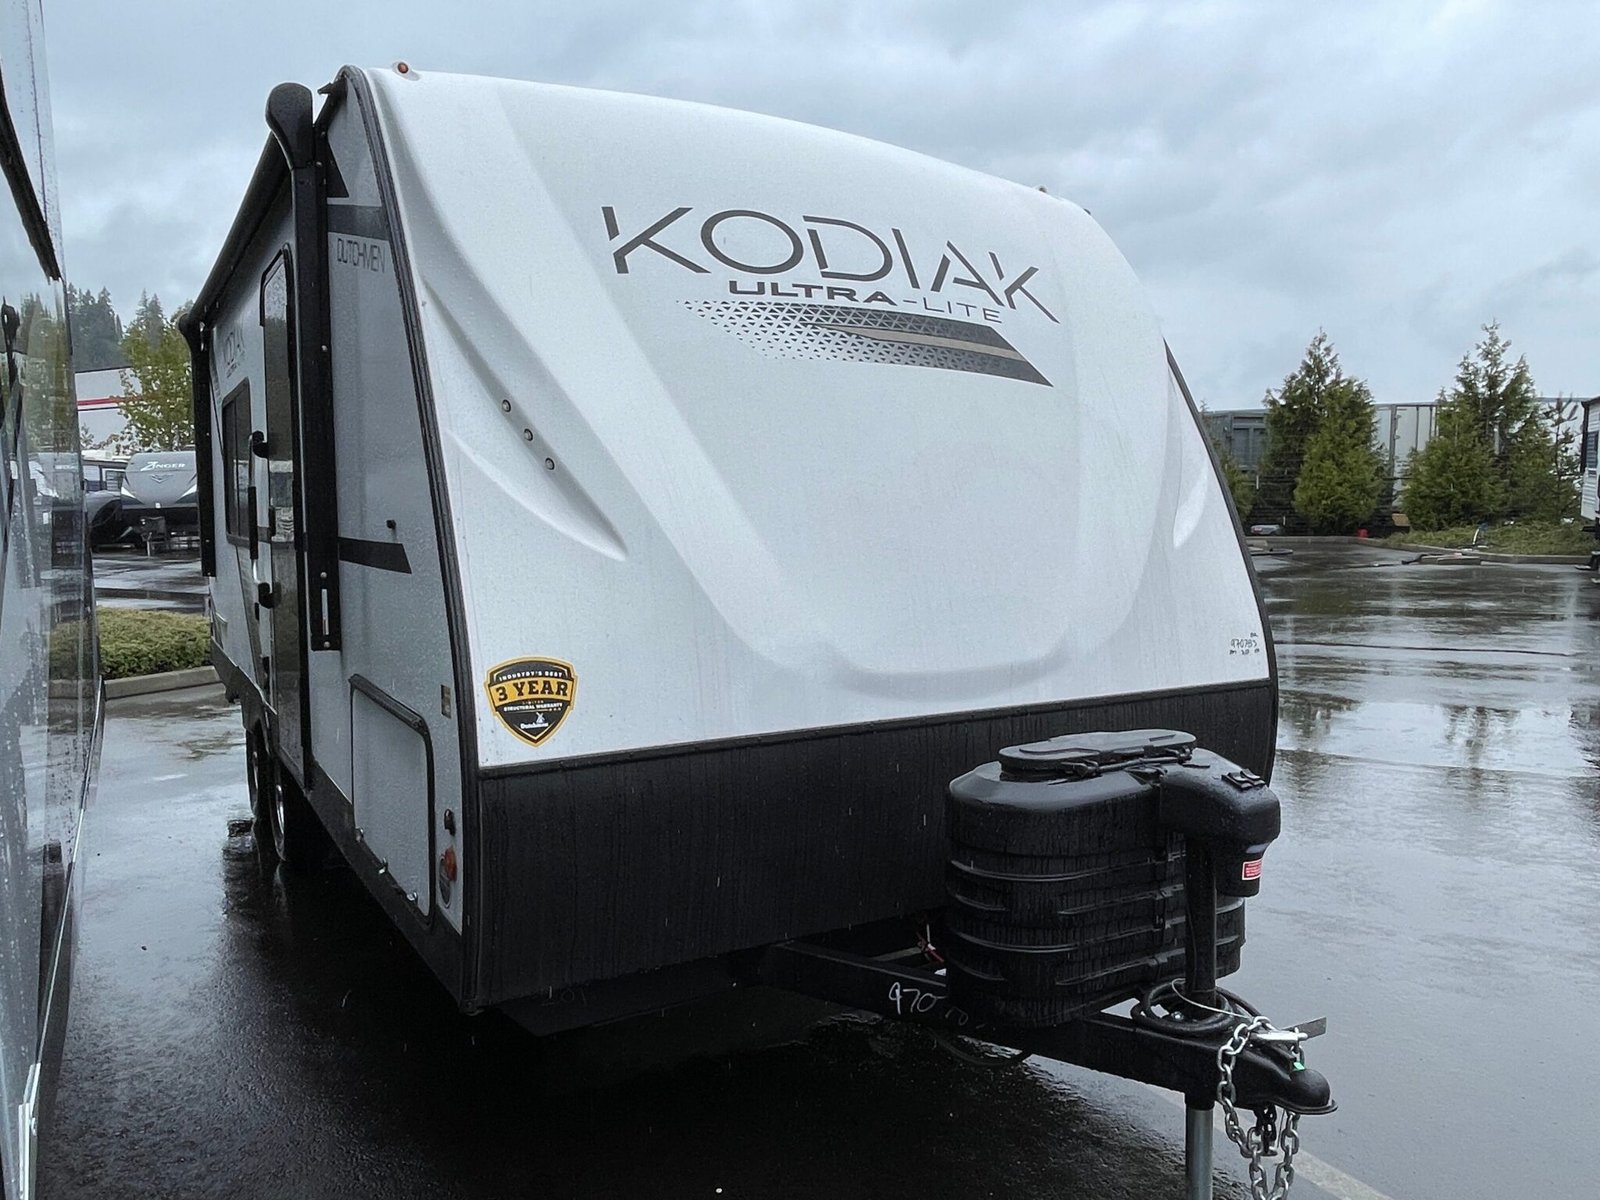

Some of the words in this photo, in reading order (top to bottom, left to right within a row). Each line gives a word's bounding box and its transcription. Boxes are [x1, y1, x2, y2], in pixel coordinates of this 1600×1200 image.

[336, 238, 387, 273] DUTCHMEN
[600, 206, 1061, 324] KODIAK
[729, 279, 1004, 323] ULTRA-LITE
[496, 686, 508, 702] 3
[513, 681, 568, 697] YEAR
